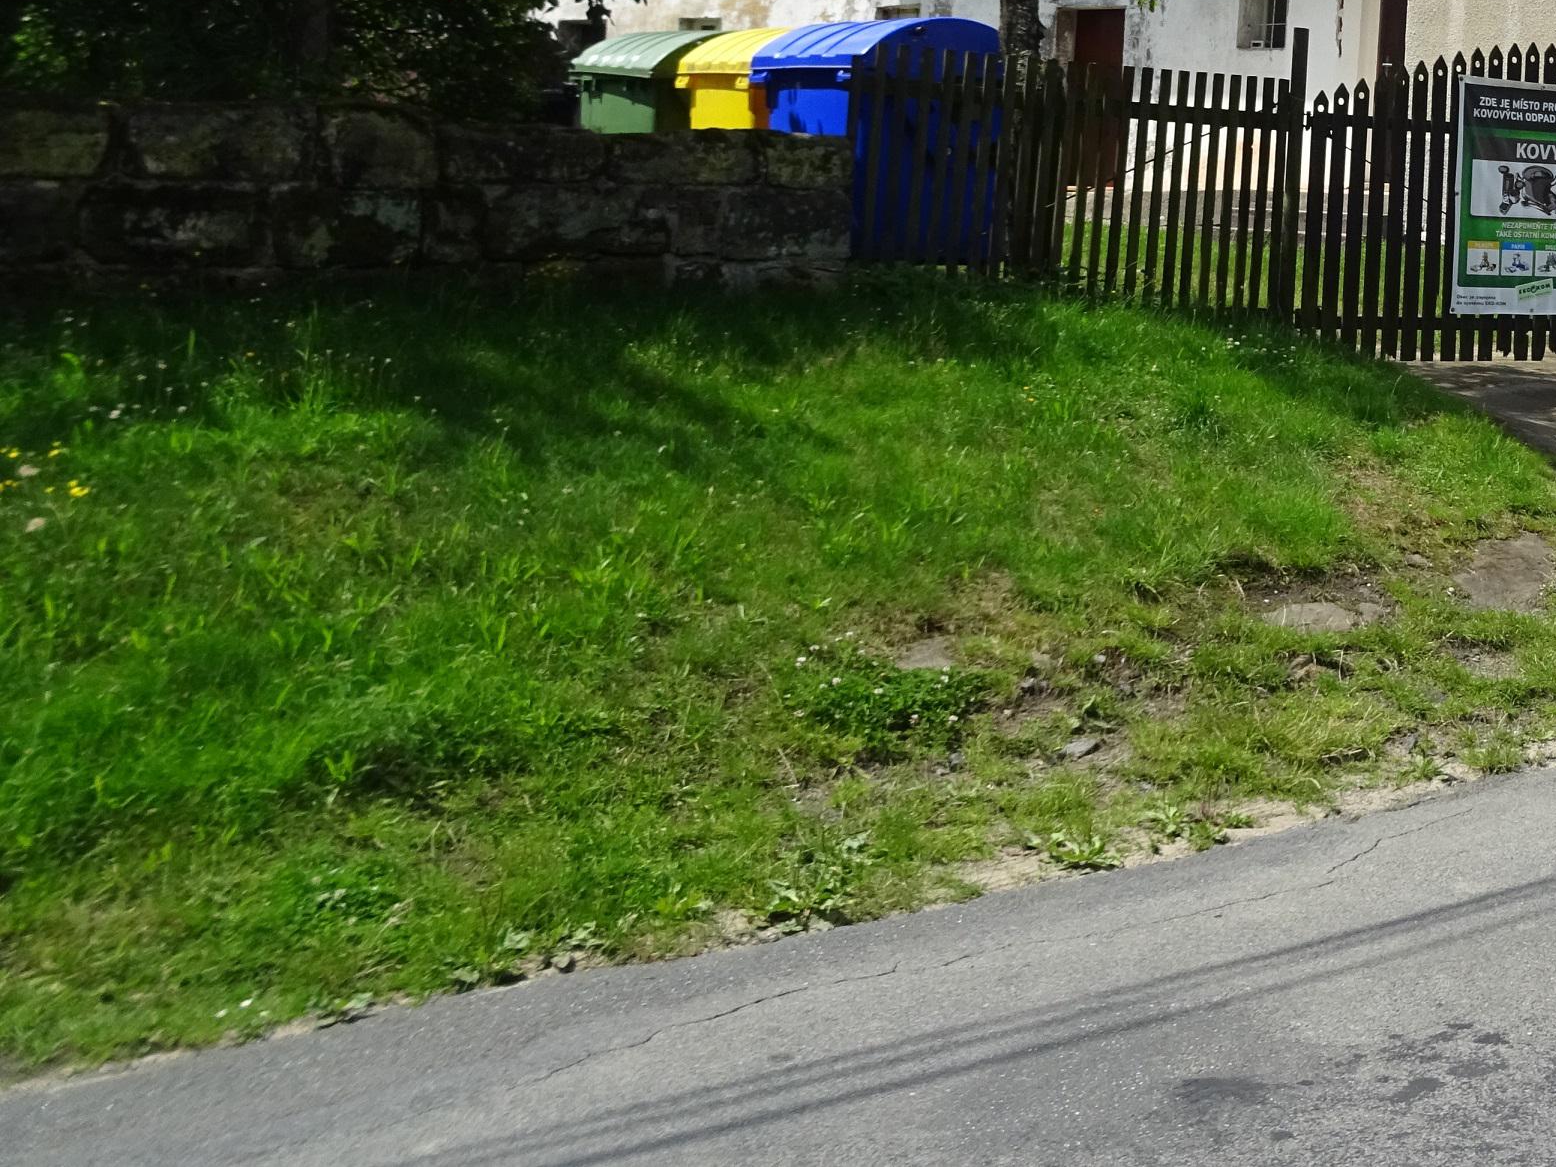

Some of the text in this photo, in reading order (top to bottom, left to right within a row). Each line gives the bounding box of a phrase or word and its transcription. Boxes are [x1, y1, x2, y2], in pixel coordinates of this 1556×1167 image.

[1480, 96, 1497, 107] ZDE
[1500, 99, 1510, 109] JE
[1512, 98, 1540, 110] MÍSTO
[1474, 108, 1523, 122] KOVOVÝCH
